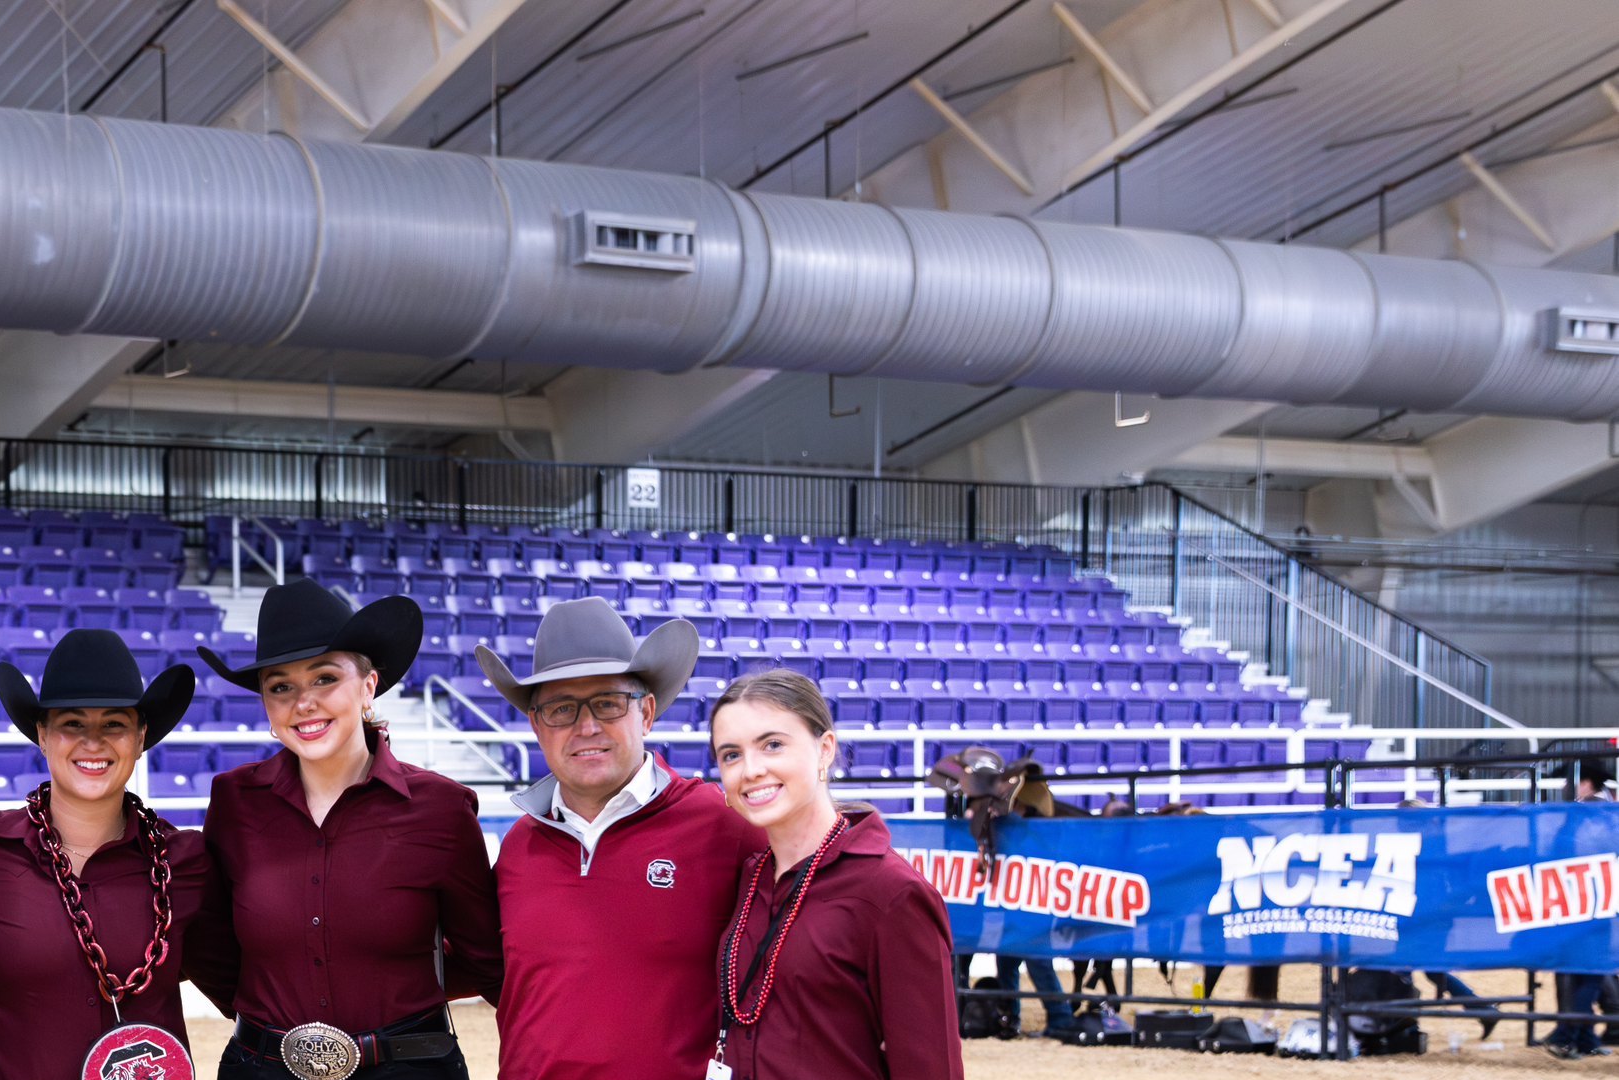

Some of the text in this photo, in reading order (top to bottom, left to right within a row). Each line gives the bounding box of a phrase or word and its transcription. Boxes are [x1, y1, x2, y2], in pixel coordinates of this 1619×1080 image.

[631, 484, 655, 502] 22
[1208, 832, 1422, 917] NCEA
[1487, 852, 1619, 934] NATI
[1222, 907, 1398, 929] NATIONAL COLLEGIATE
[1223, 920, 1399, 941] EQUESTRIAN ASSOCIATION
[297, 1042, 341, 1053] AQHYA
